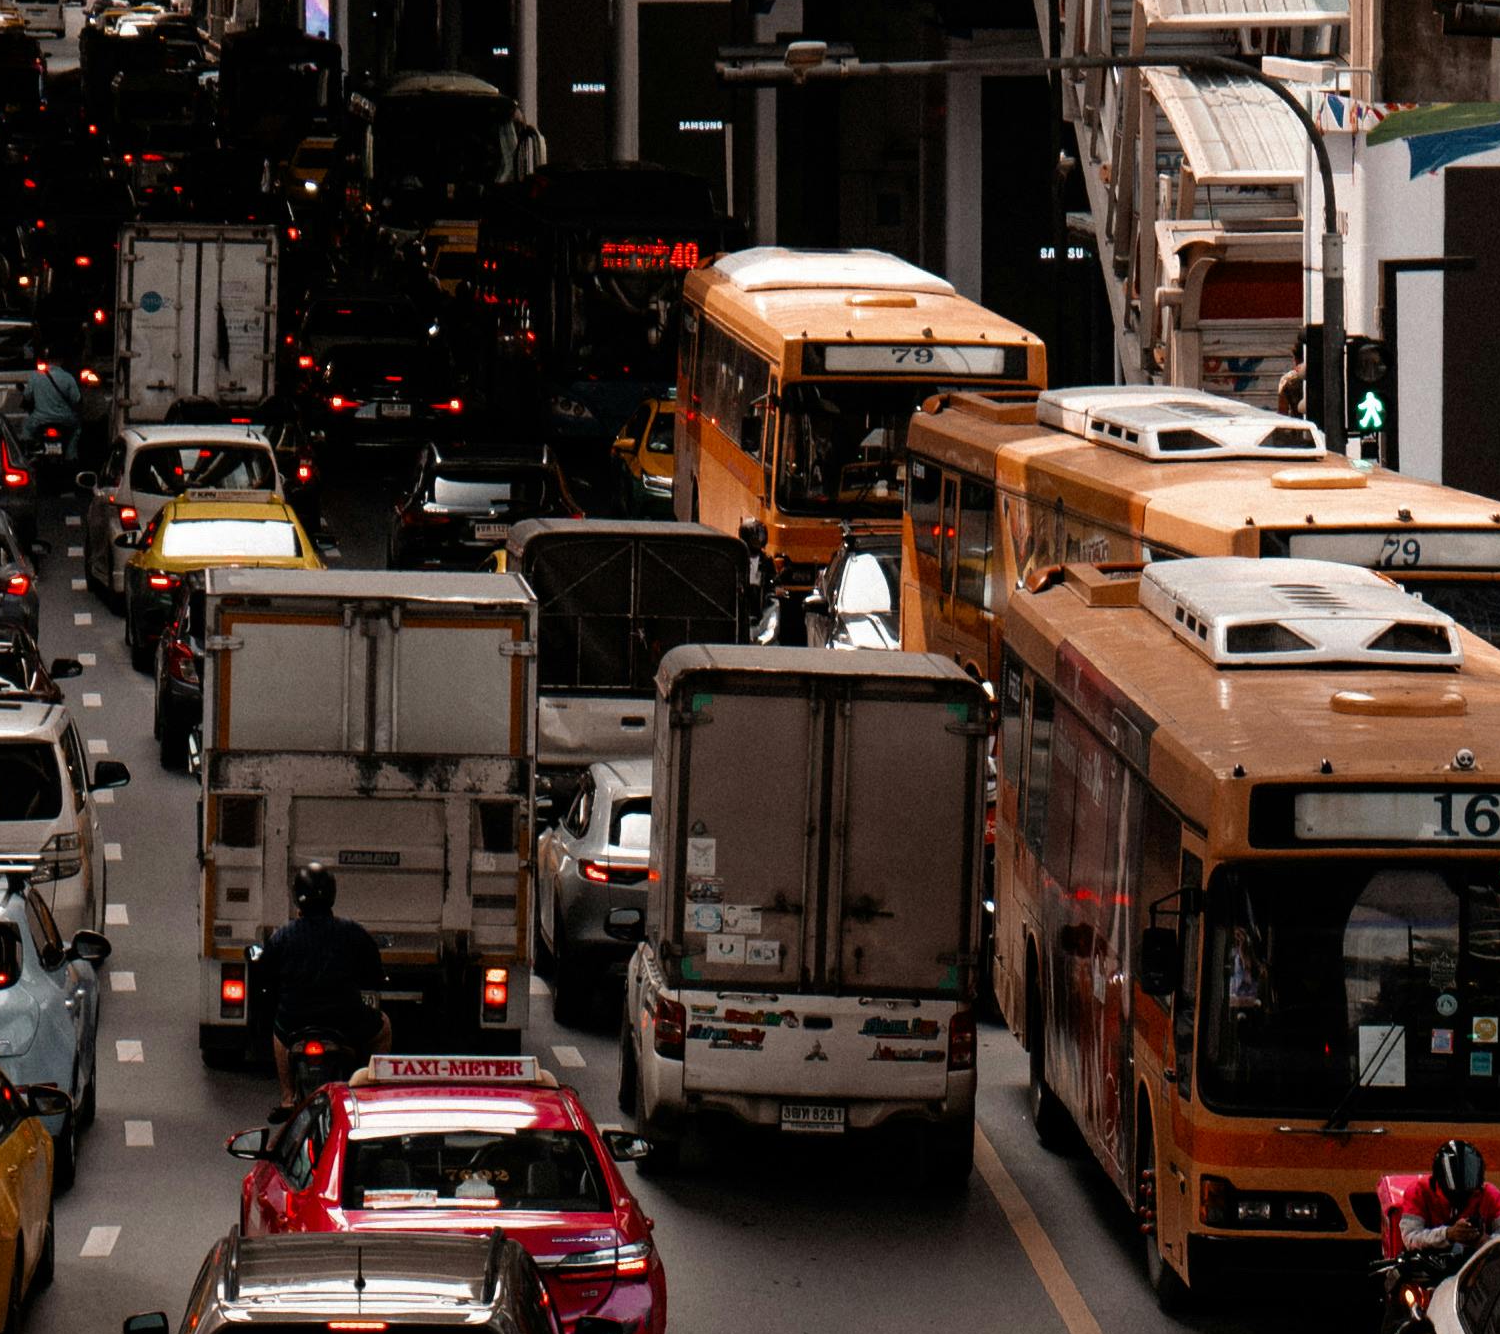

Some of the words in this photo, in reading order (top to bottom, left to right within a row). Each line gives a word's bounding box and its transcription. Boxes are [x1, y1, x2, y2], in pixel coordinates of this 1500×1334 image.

[679, 119, 723, 132] SAMSUNG
[891, 347, 935, 365] 79
[1382, 534, 1421, 567] 79
[1434, 791, 1500, 838] 16
[390, 1060, 524, 1078] TAXI-METER
